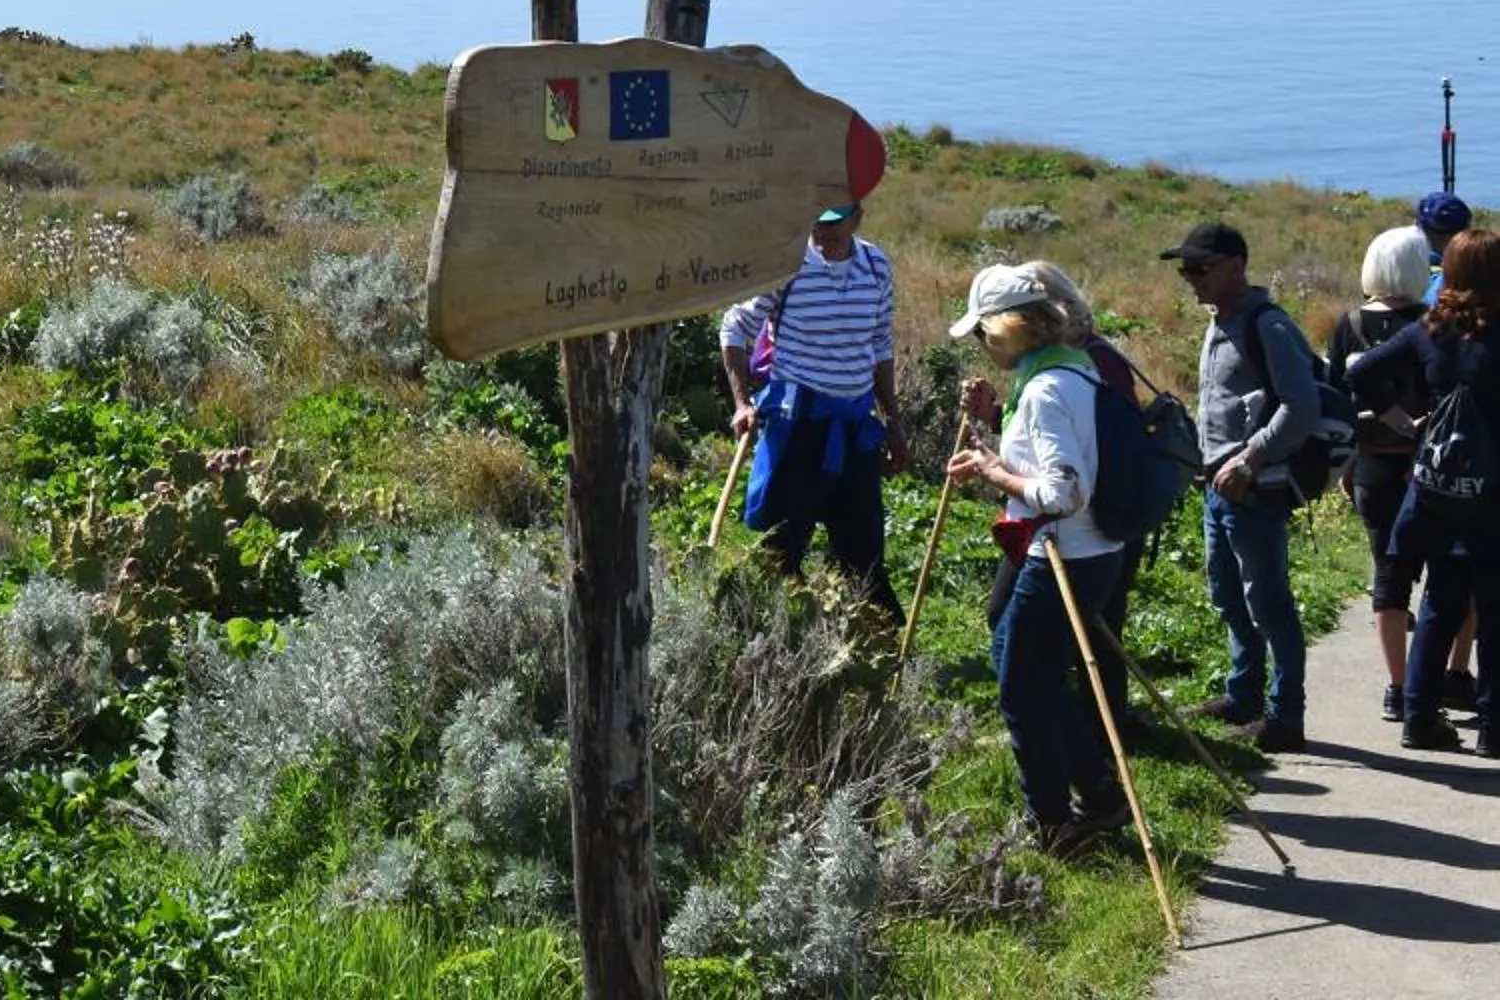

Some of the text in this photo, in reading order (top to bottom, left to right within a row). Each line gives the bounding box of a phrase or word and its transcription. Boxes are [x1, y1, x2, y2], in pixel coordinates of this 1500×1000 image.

[545, 255, 750, 308] Laghetto di Venere
[1450, 477, 1485, 495] JEY
